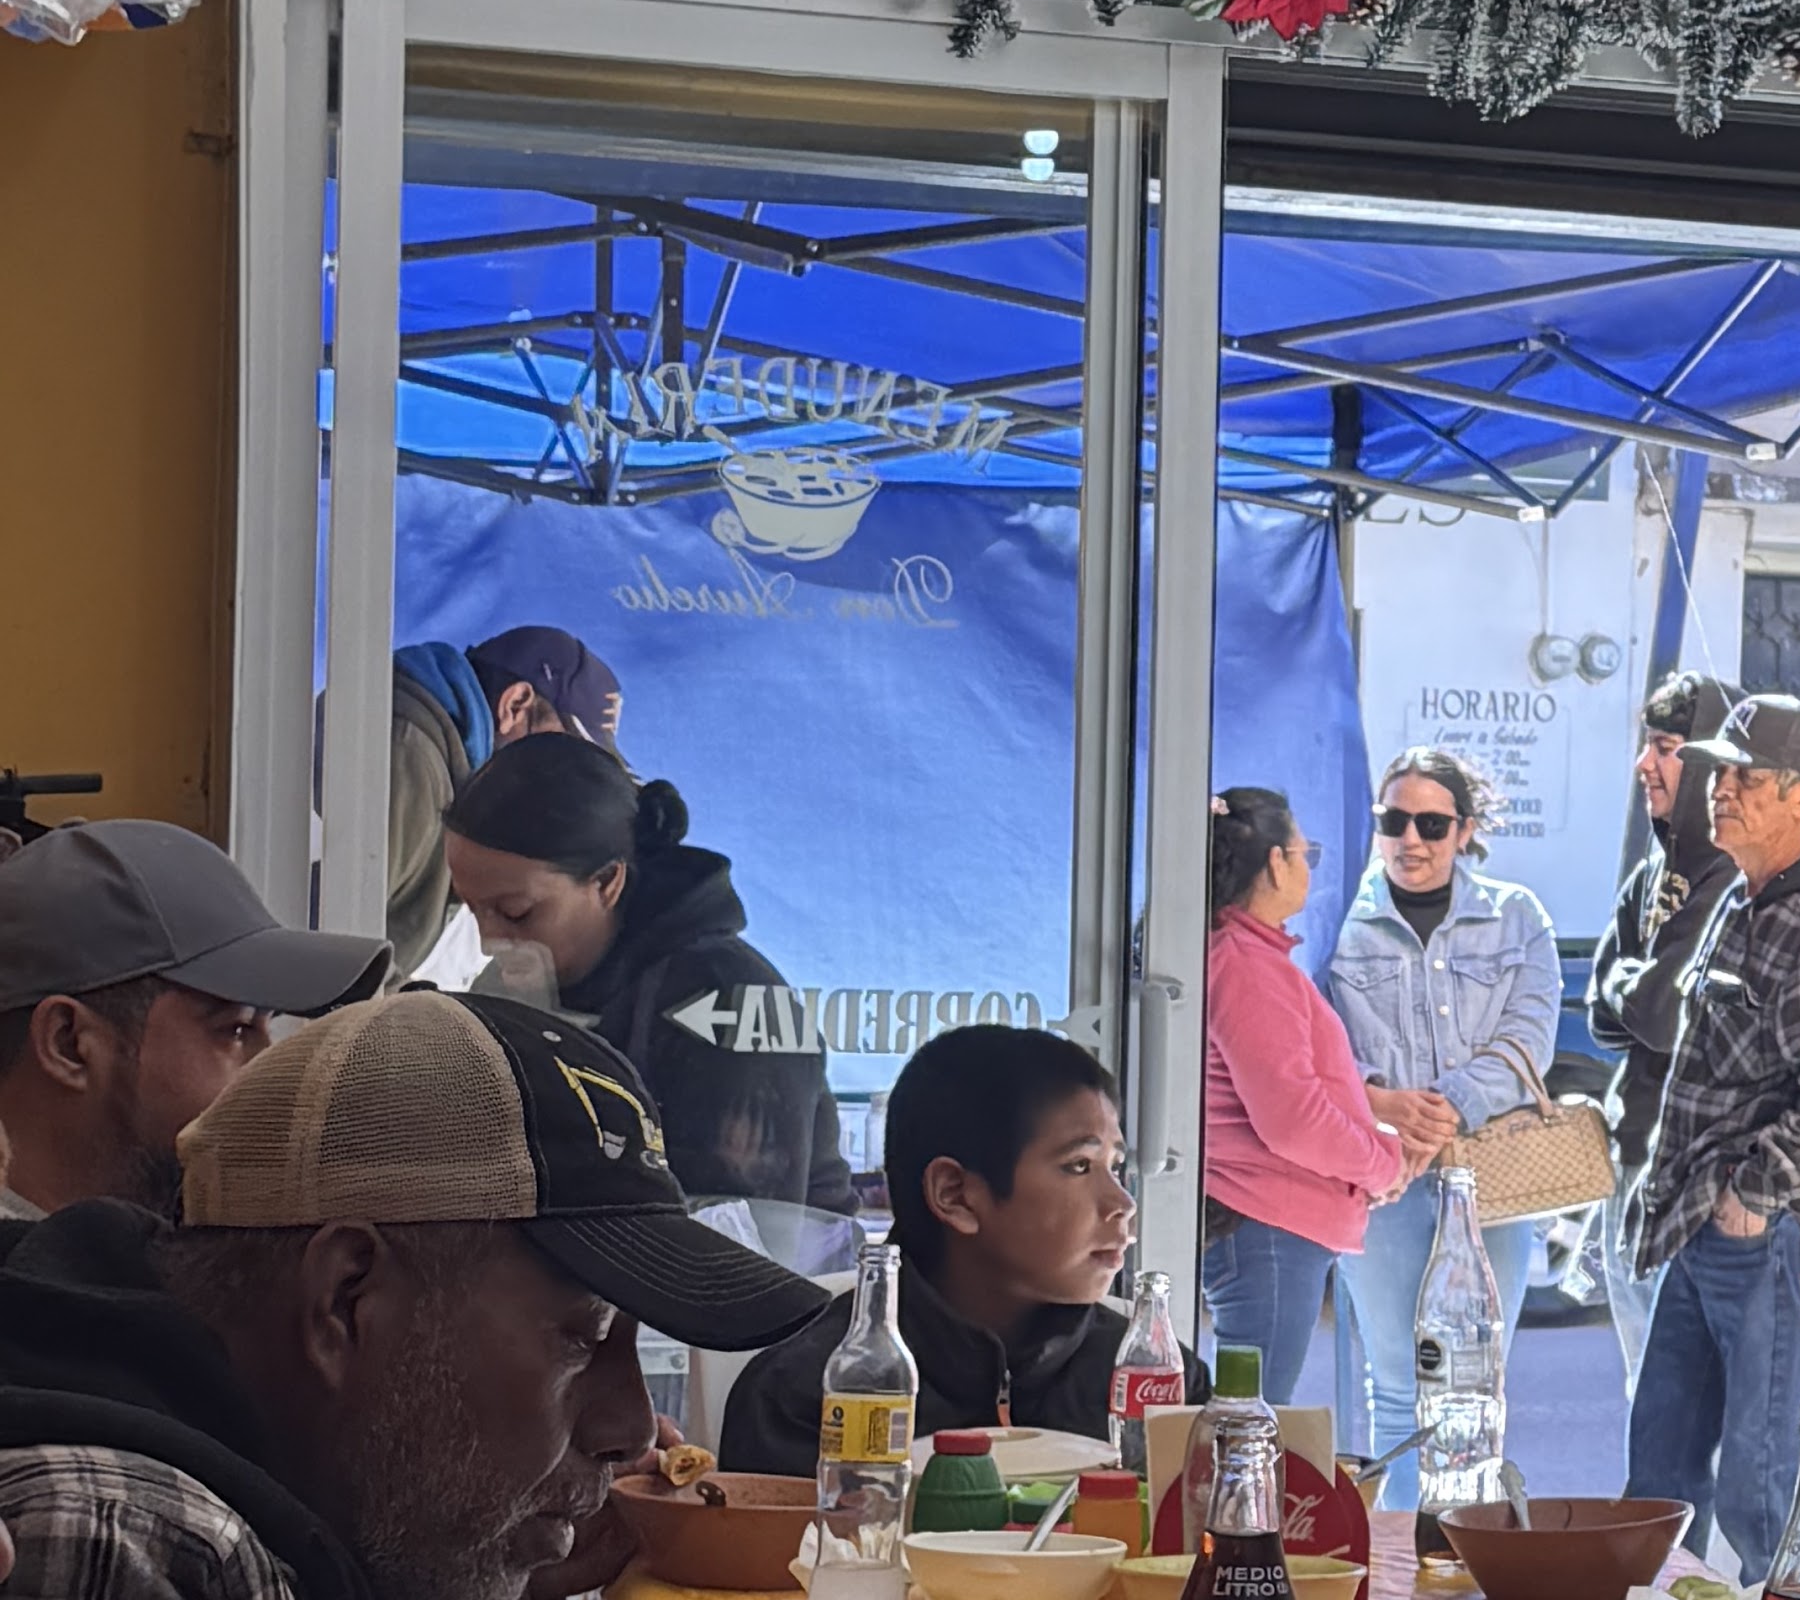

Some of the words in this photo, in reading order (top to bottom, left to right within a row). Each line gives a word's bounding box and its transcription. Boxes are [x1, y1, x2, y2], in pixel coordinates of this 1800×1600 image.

[1420, 686, 1556, 722] HORARIO
[1216, 1565, 1285, 1581] MEDIO
[1212, 1582, 1275, 1597] LITRO
